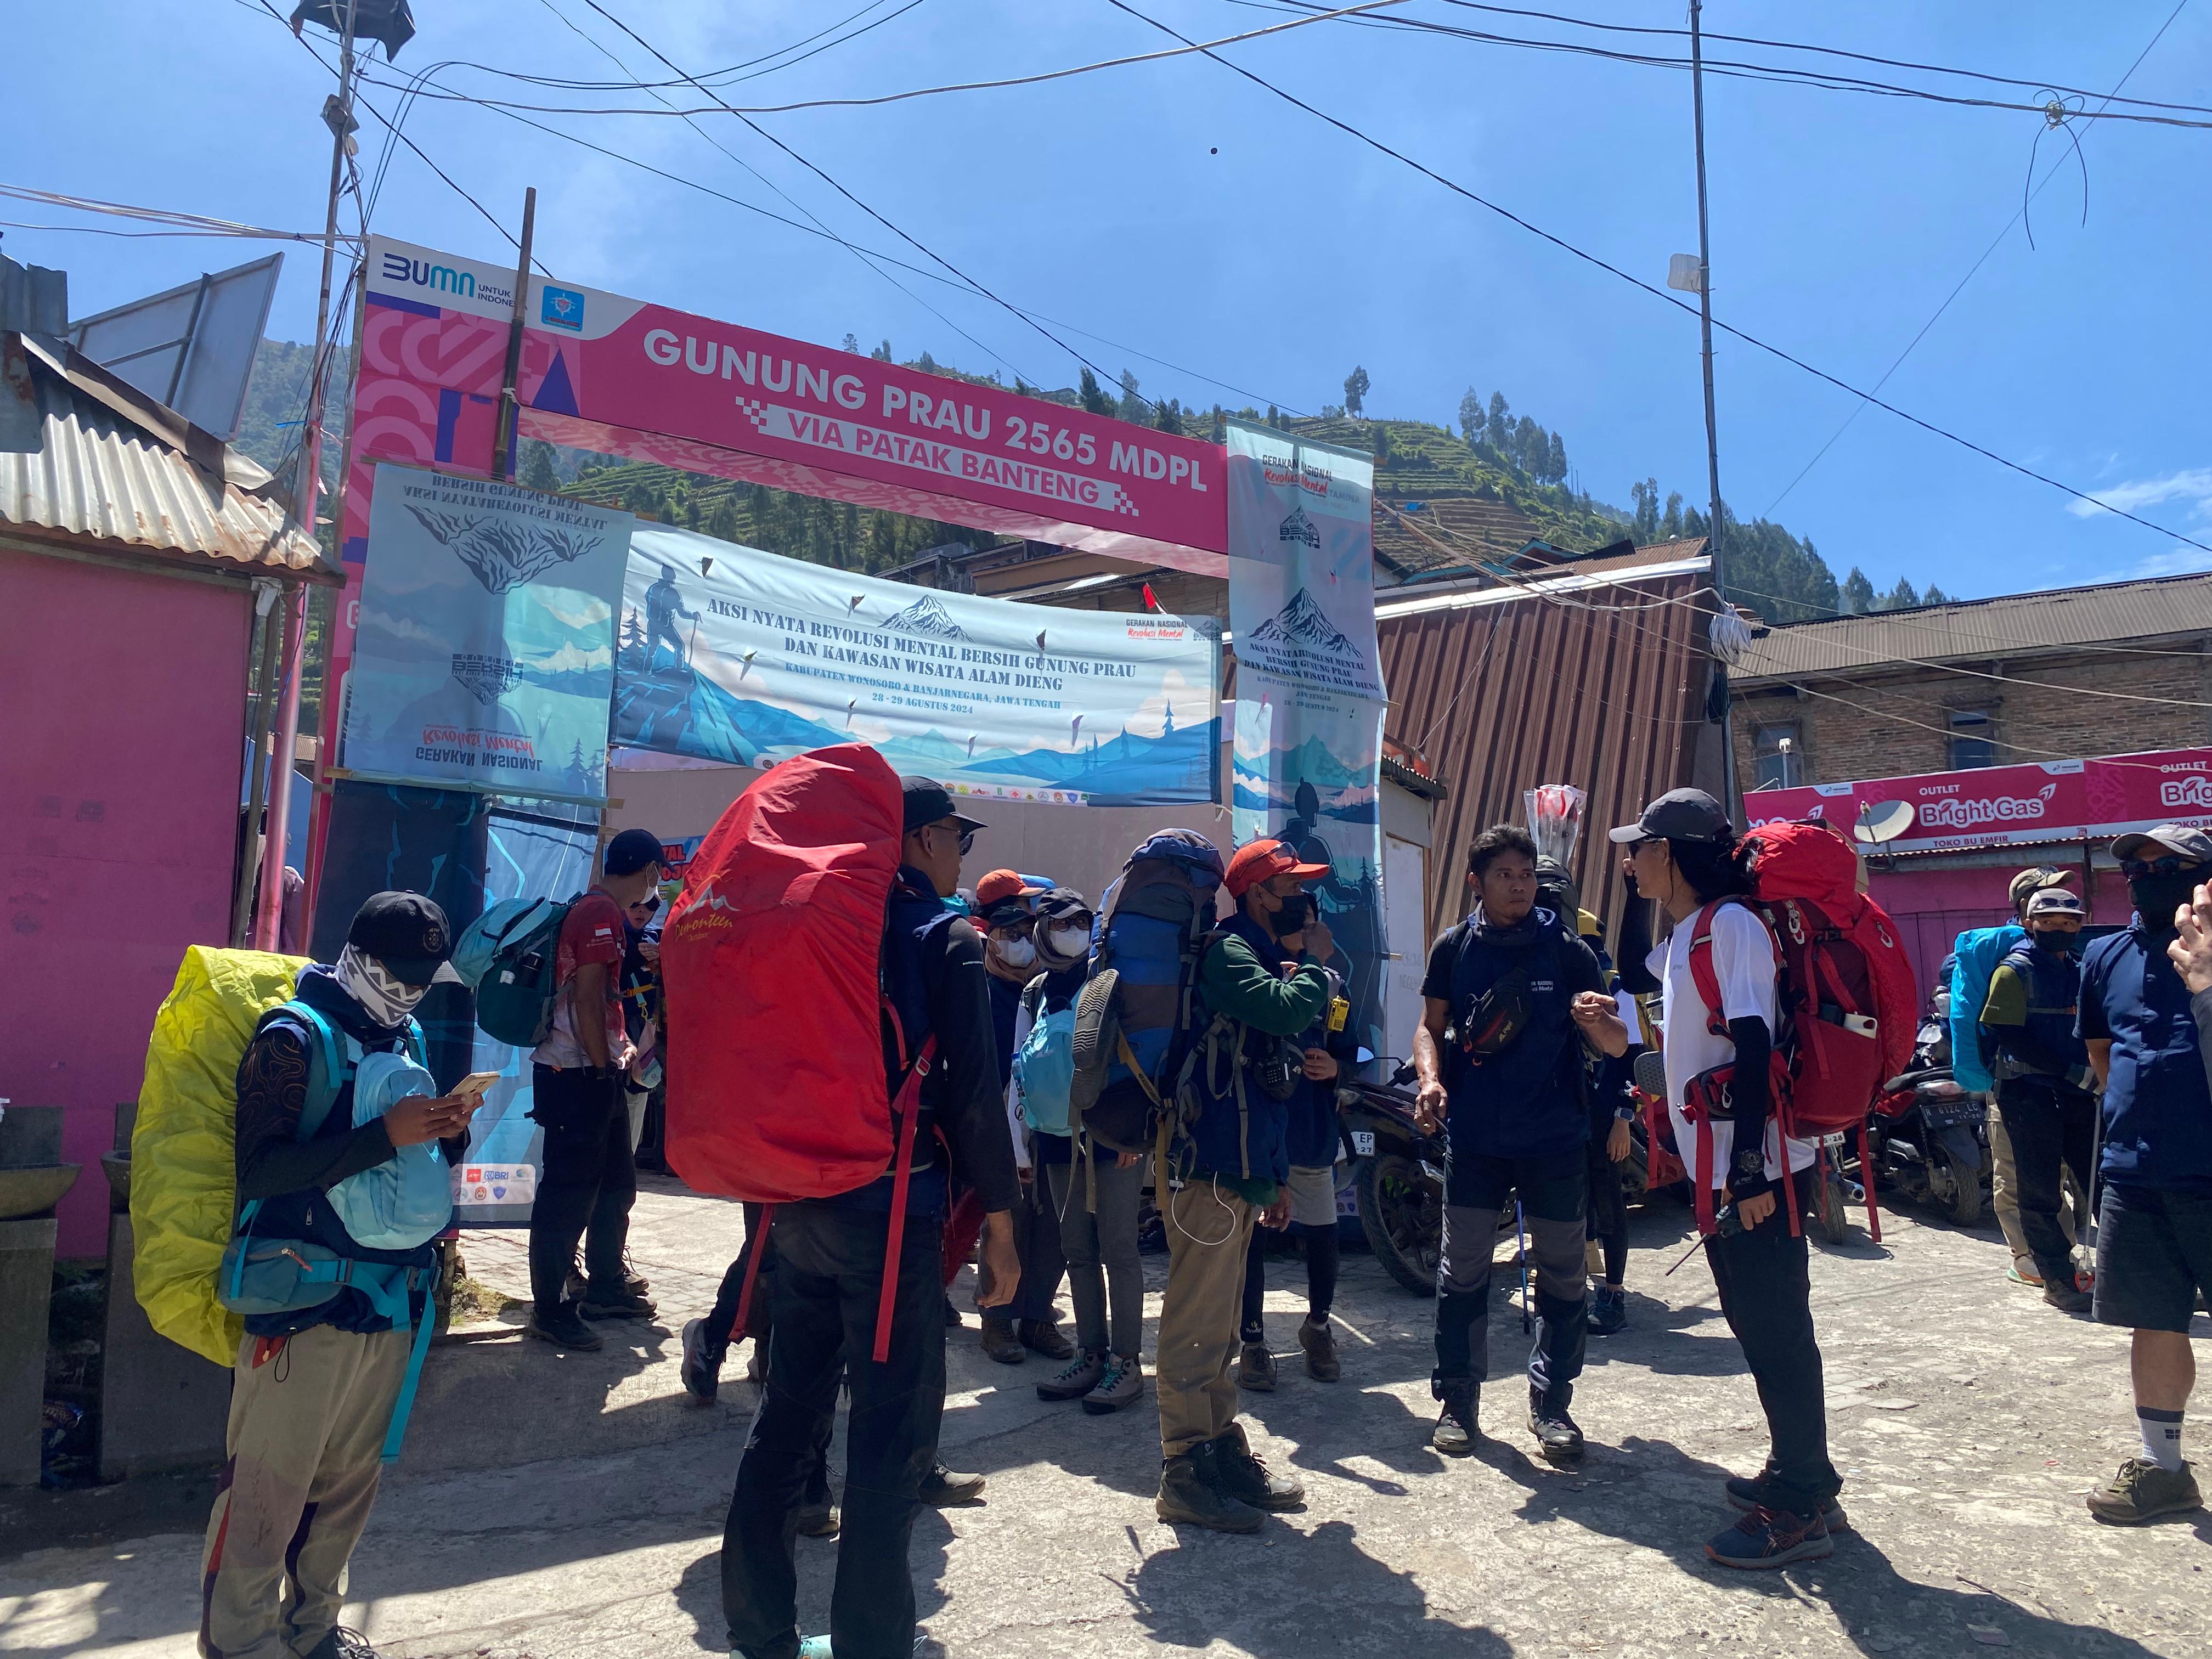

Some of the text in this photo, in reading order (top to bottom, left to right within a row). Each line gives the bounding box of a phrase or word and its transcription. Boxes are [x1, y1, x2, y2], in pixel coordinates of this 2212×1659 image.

[479, 284, 510, 298] UNTUK
[478, 293, 528, 311] INDONE
[644, 329, 1207, 492] GUNUNG PRAU 2565 MDPL
[788, 413, 1098, 504] VIA PATAK BANTENG
[1262, 455, 1332, 482] GERAKAN NASIONAL
[1301, 477, 1328, 493] Mental
[1126, 619, 1154, 628] GERAKAN
[707, 599, 1136, 678] AKSI NYATA REVOLUSI MENTAL BERSIH GUNUNG PRAU
[1128, 628, 1184, 637] Revolusi Mental
[785, 637, 1063, 691] DAN KAWASAN WISATA ALAM DIENG
[1249, 643, 1268, 653] AKSI
[1335, 659, 1366, 671] MENTAL
[1244, 659, 1379, 691] DAN KAWASAN WISATA ALAM DIENG
[1267, 656, 1352, 678] BERSIH GUNUNG PRAU
[785, 663, 845, 681] KABUPATEN
[848, 674, 901, 691] WONOSOBO
[913, 685, 992, 704] BANJARNEGARA,
[994, 694, 1021, 707] JAWA
[1023, 697, 1060, 709] TENGAH
[1257, 676, 1290, 688] KABUPATEN
[1292, 682, 1320, 692] WONSOBO
[872, 692, 884, 702] 28
[891, 695, 902, 705] 29
[905, 697, 949, 712] AGUSTUS
[951, 703, 973, 714] 2024
[1309, 693, 1331, 702] TENGAH
[2160, 761, 2207, 772] OUTLET
[1919, 784, 1960, 795] OUTLET
[1921, 798, 2042, 826] Bright Gas
[1933, 838, 1961, 847] TOKO
[1980, 835, 2008, 844] EMFIR
[1925, 1108, 1932, 1116] R
[1360, 1133, 1373, 1143] EP
[495, 1171, 509, 1180] BRI
